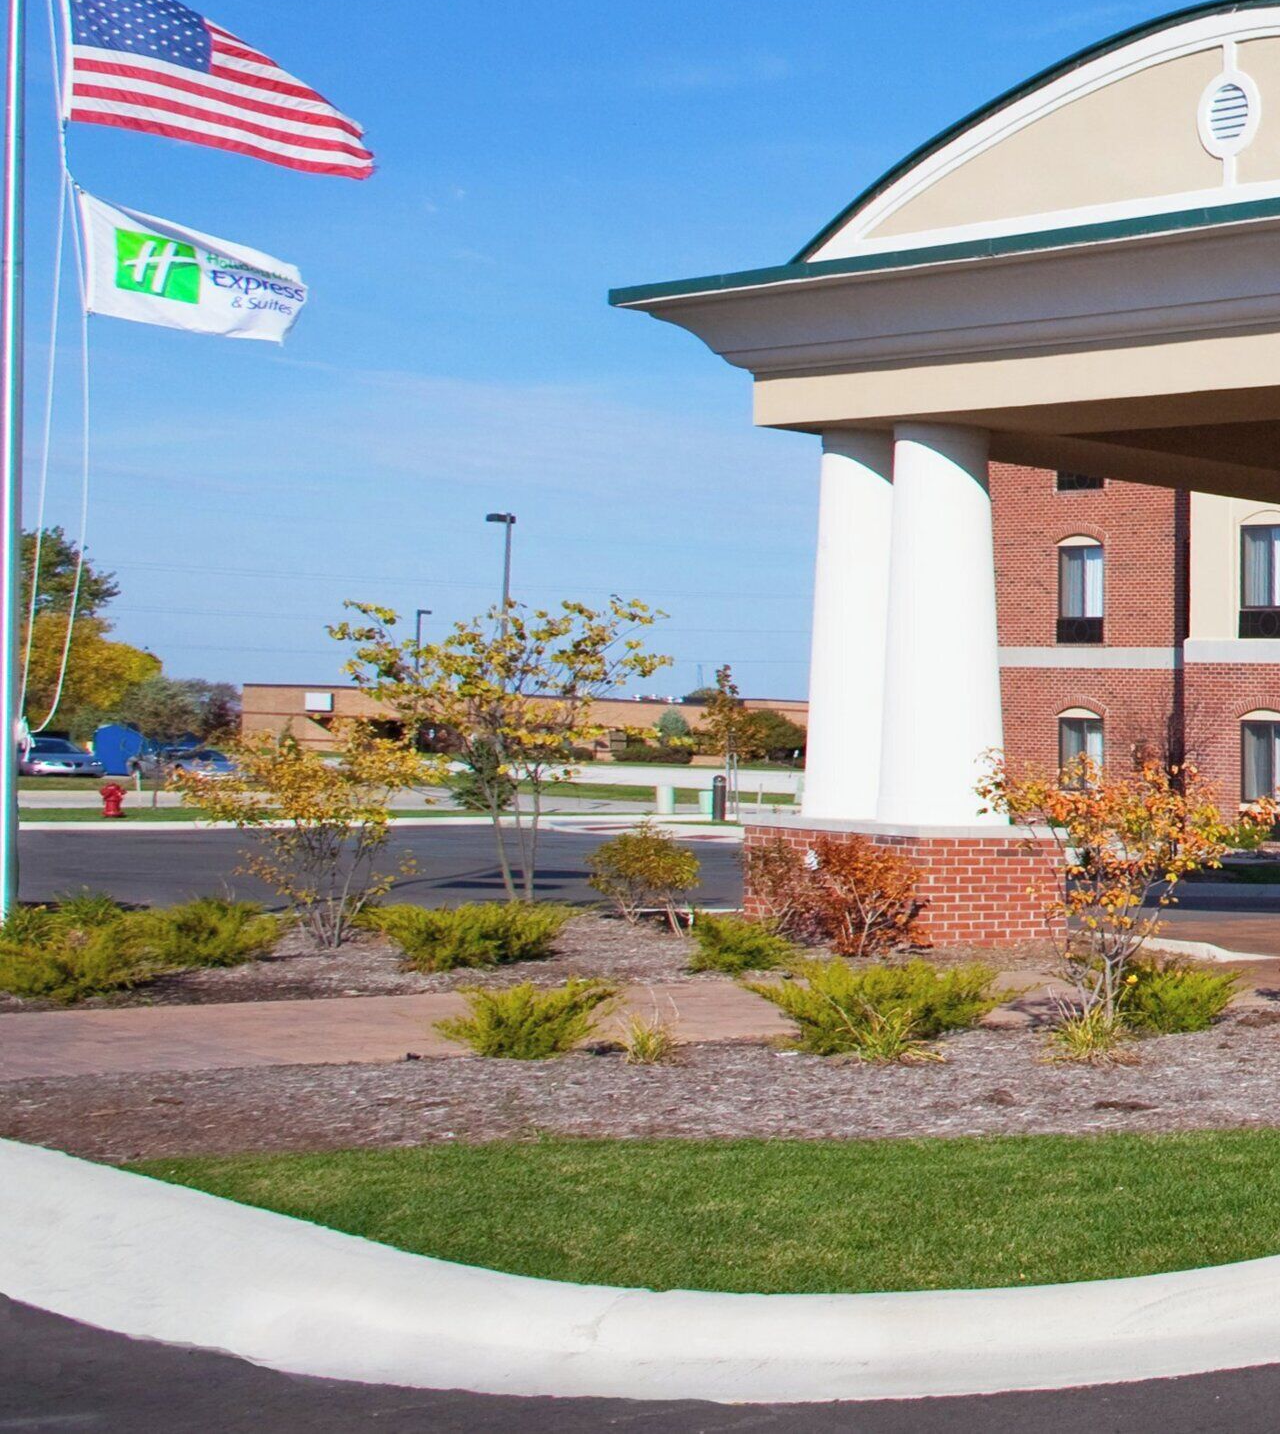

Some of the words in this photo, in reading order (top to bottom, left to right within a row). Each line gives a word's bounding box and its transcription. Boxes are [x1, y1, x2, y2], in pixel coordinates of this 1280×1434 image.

[211, 270, 304, 303] Express
[231, 296, 242, 309] &
[247, 297, 293, 316] Suites
